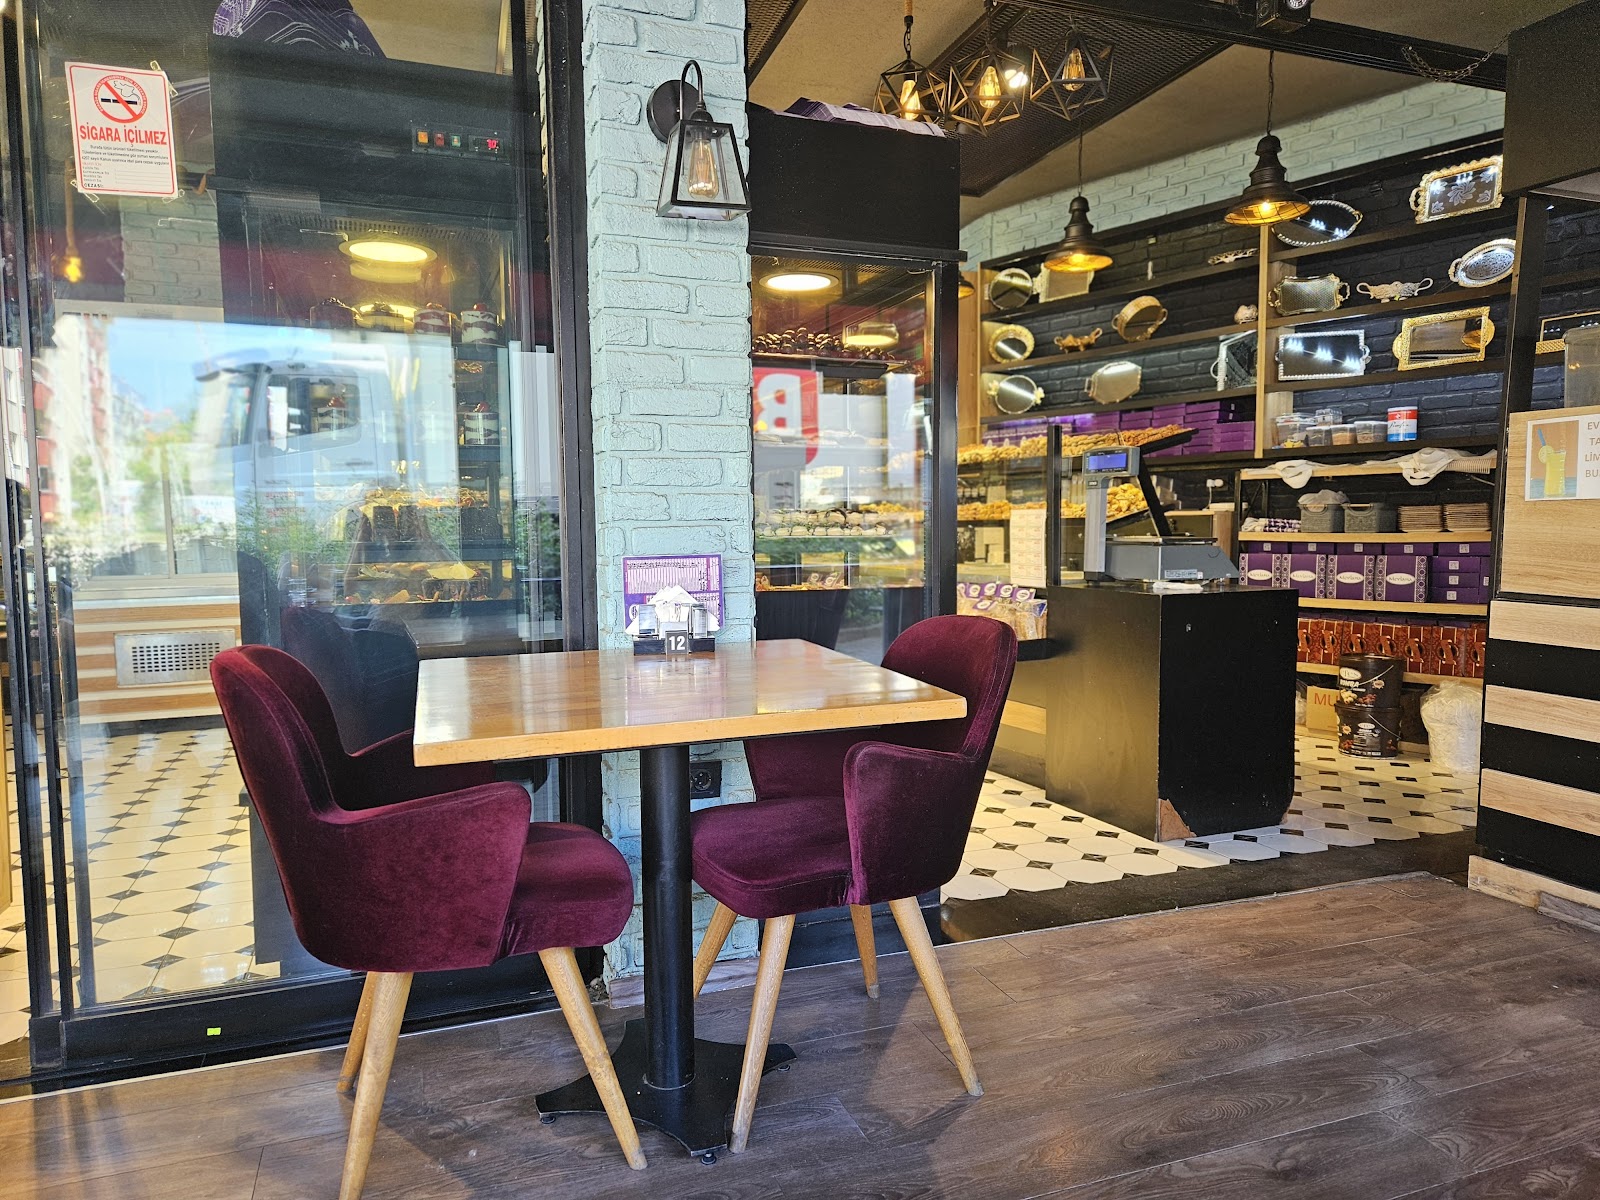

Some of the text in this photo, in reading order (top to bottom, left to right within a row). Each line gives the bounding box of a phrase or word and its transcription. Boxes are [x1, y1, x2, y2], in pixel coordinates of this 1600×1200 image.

[80, 122, 167, 147] SİGARA İÇİLMEZ
[1585, 469, 1600, 478] BU
[668, 636, 686, 651] 12
